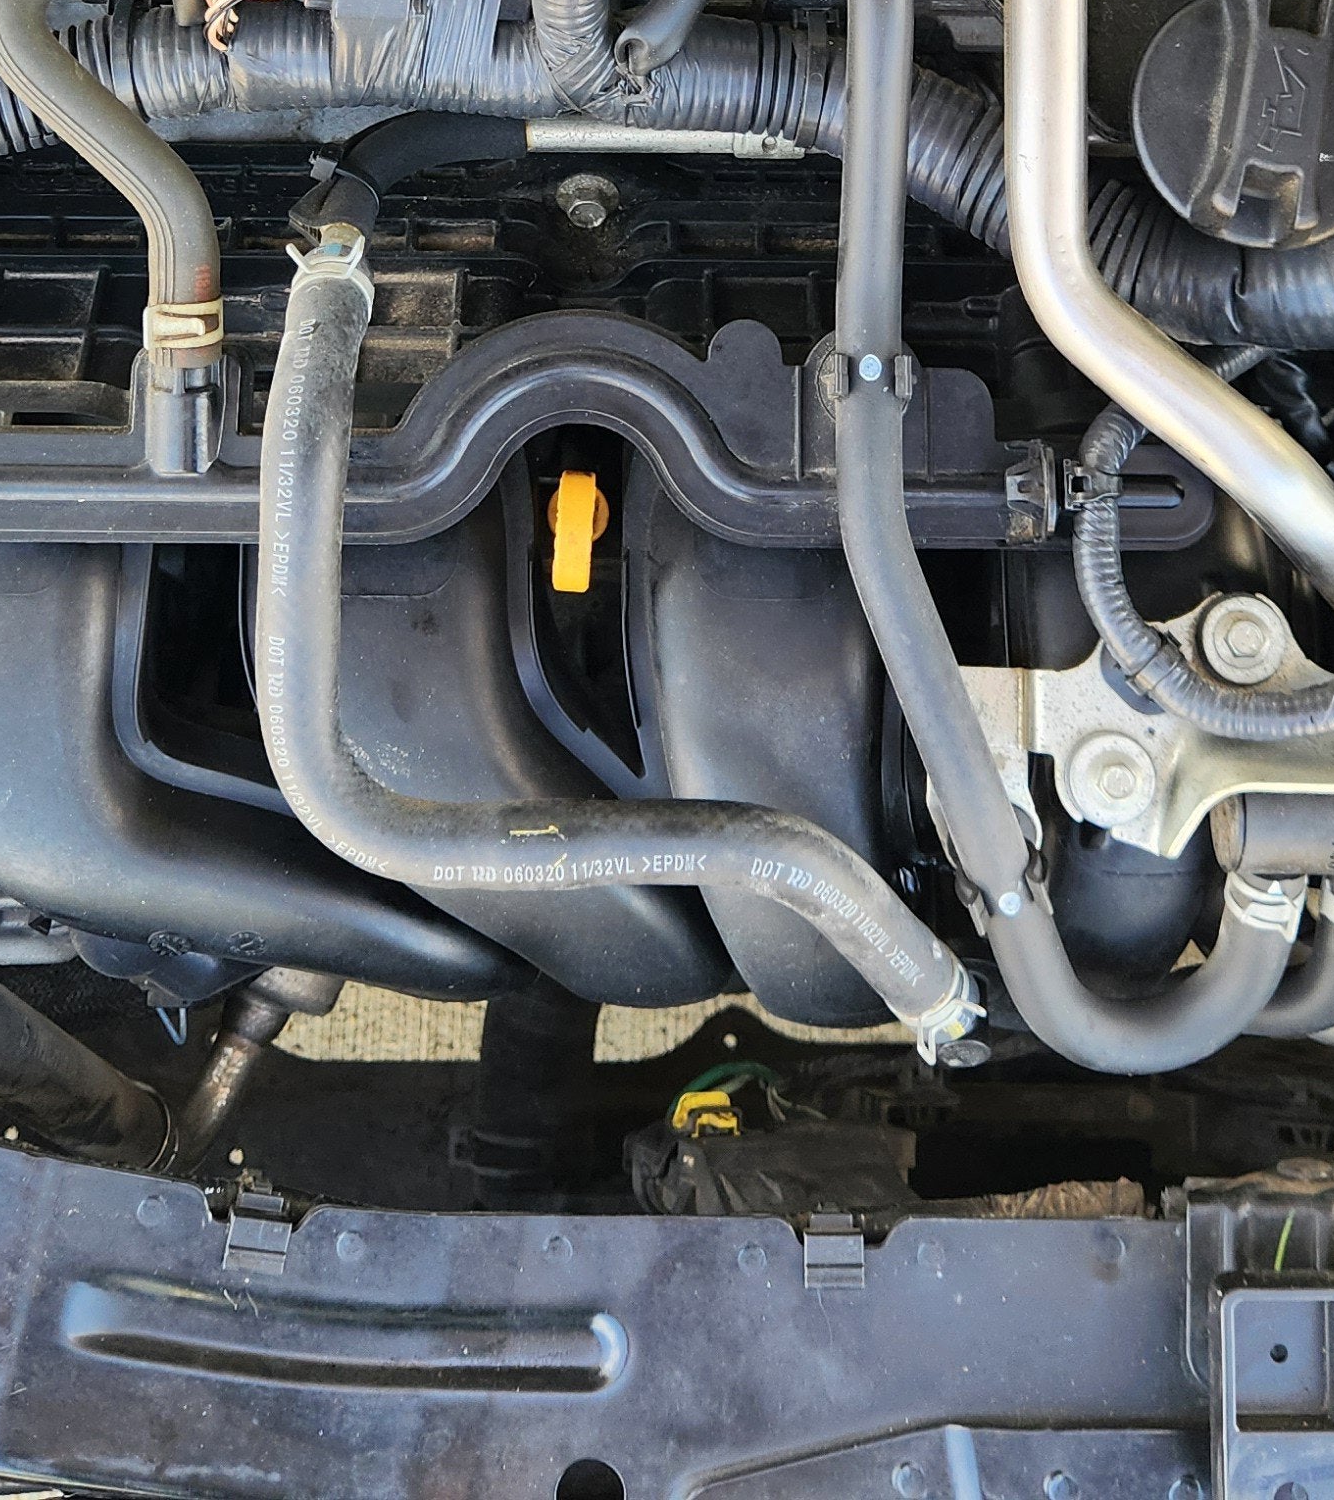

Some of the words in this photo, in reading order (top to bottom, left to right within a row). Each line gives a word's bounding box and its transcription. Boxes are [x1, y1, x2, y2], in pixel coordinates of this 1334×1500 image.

[297, 318, 317, 341] DOT
[282, 374, 305, 441] 060320
[268, 635, 285, 667] DOT
[269, 705, 290, 768] 060320
[433, 864, 466, 882] DOT
[503, 864, 566, 884] 060320
[570, 857, 635, 881] 11/32VL
[750, 856, 785, 881] DOT
[812, 880, 858, 919] 060320
